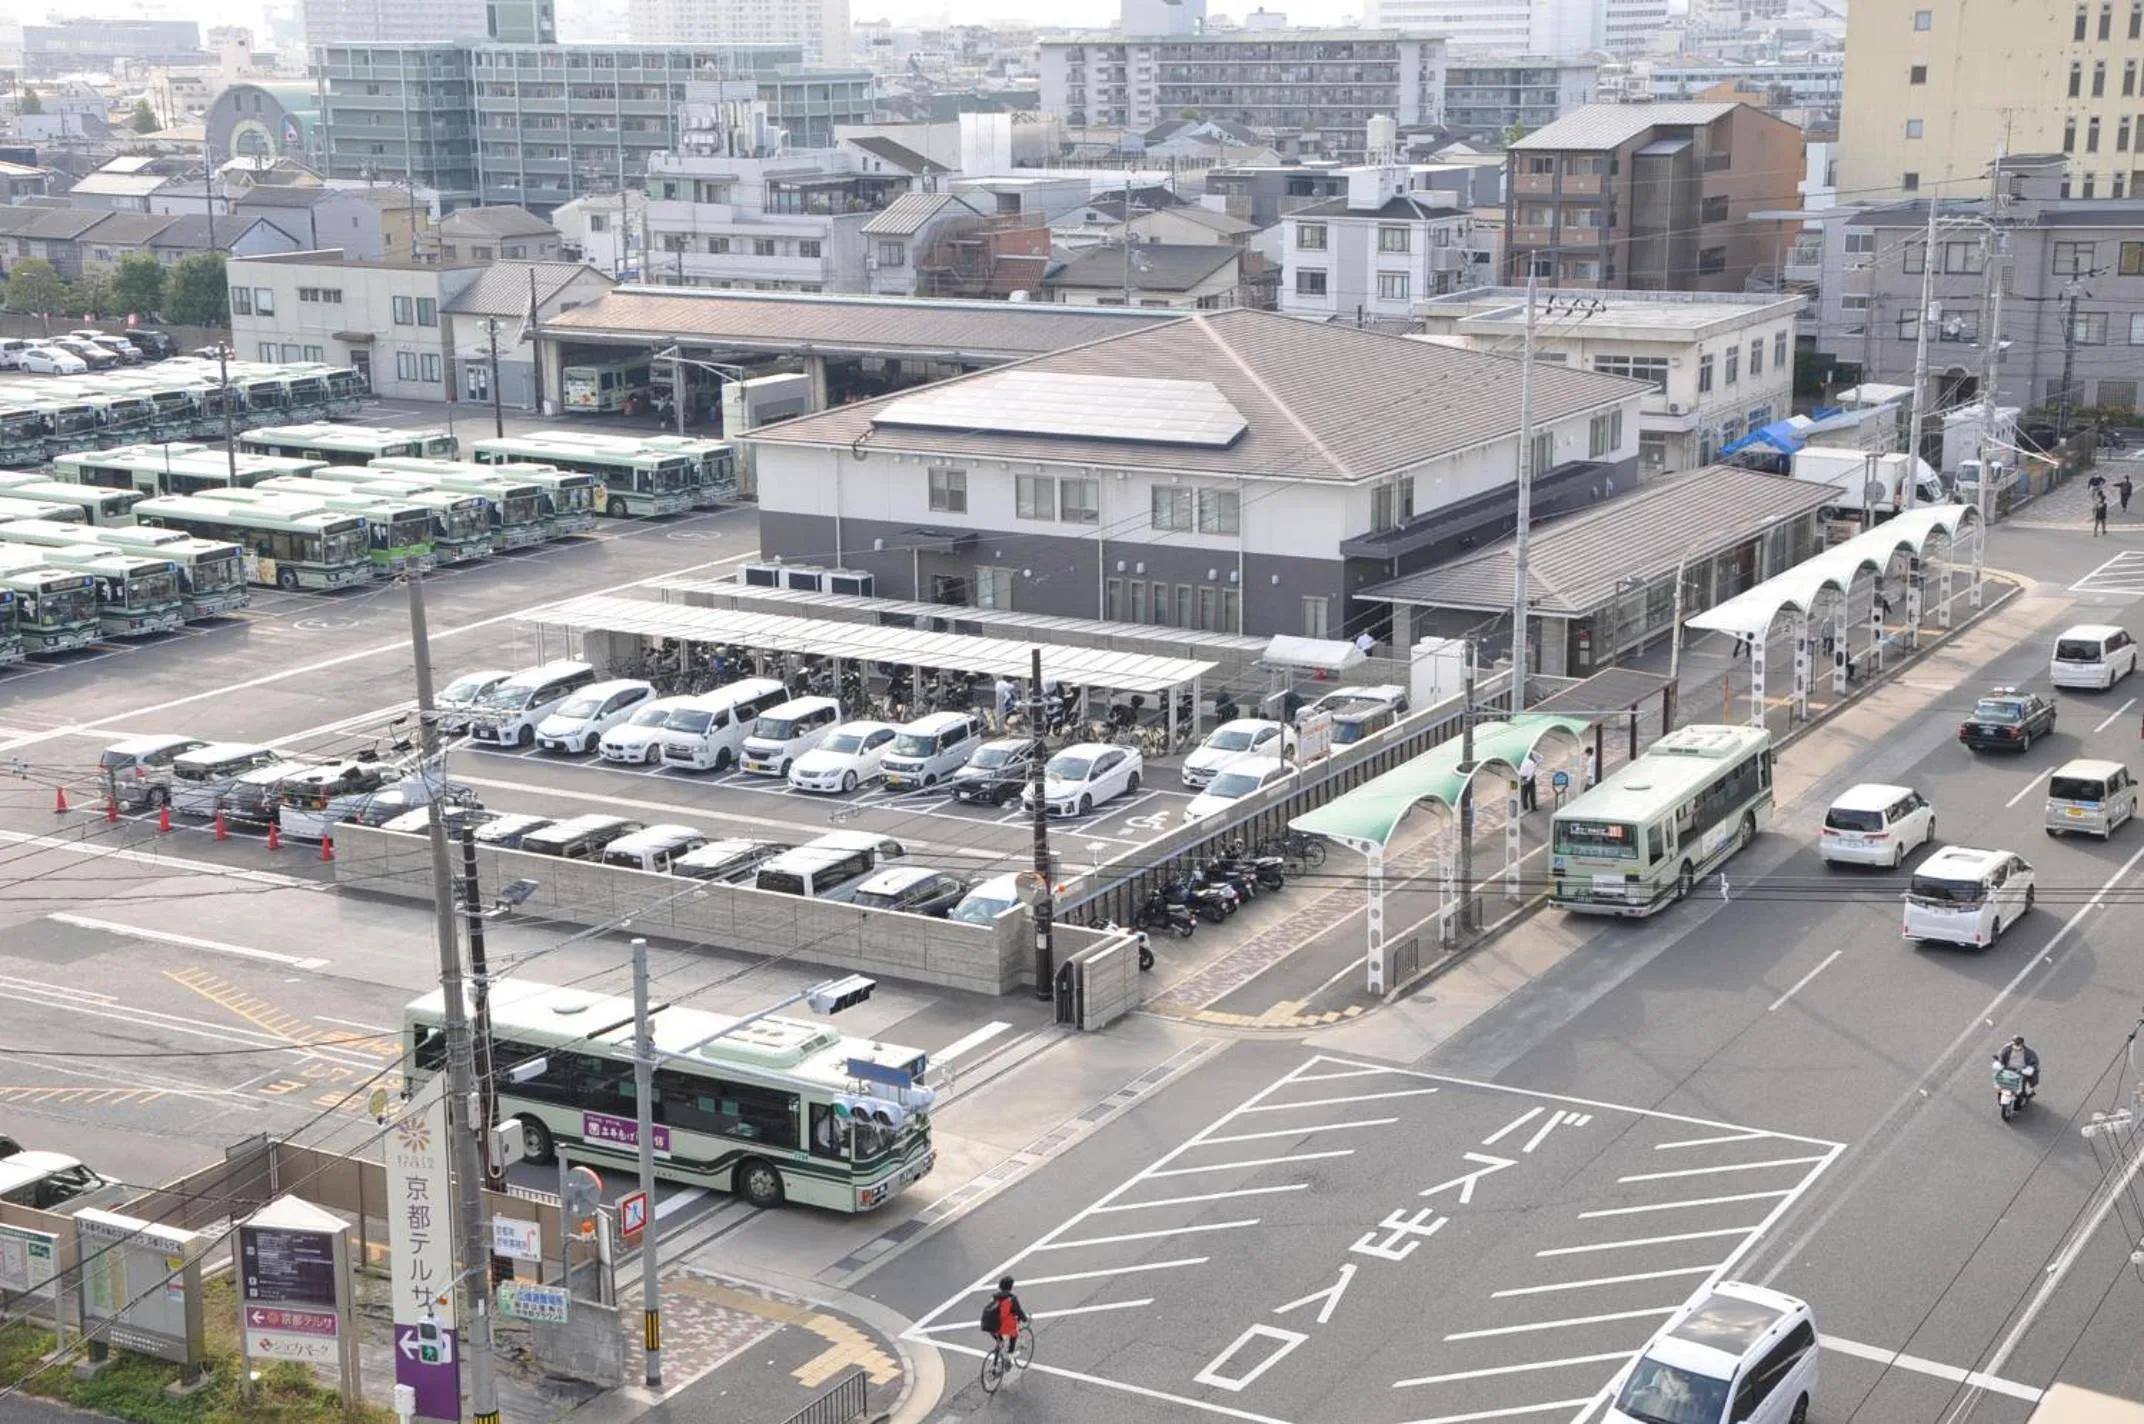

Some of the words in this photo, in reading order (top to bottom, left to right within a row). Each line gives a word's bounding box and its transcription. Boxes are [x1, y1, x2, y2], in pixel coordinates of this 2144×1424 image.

[405, 1175, 434, 1308] 京都テルサ
[1193, 1106, 1593, 1391] バス出入口
[281, 1313, 332, 1329] 京都テルサ
